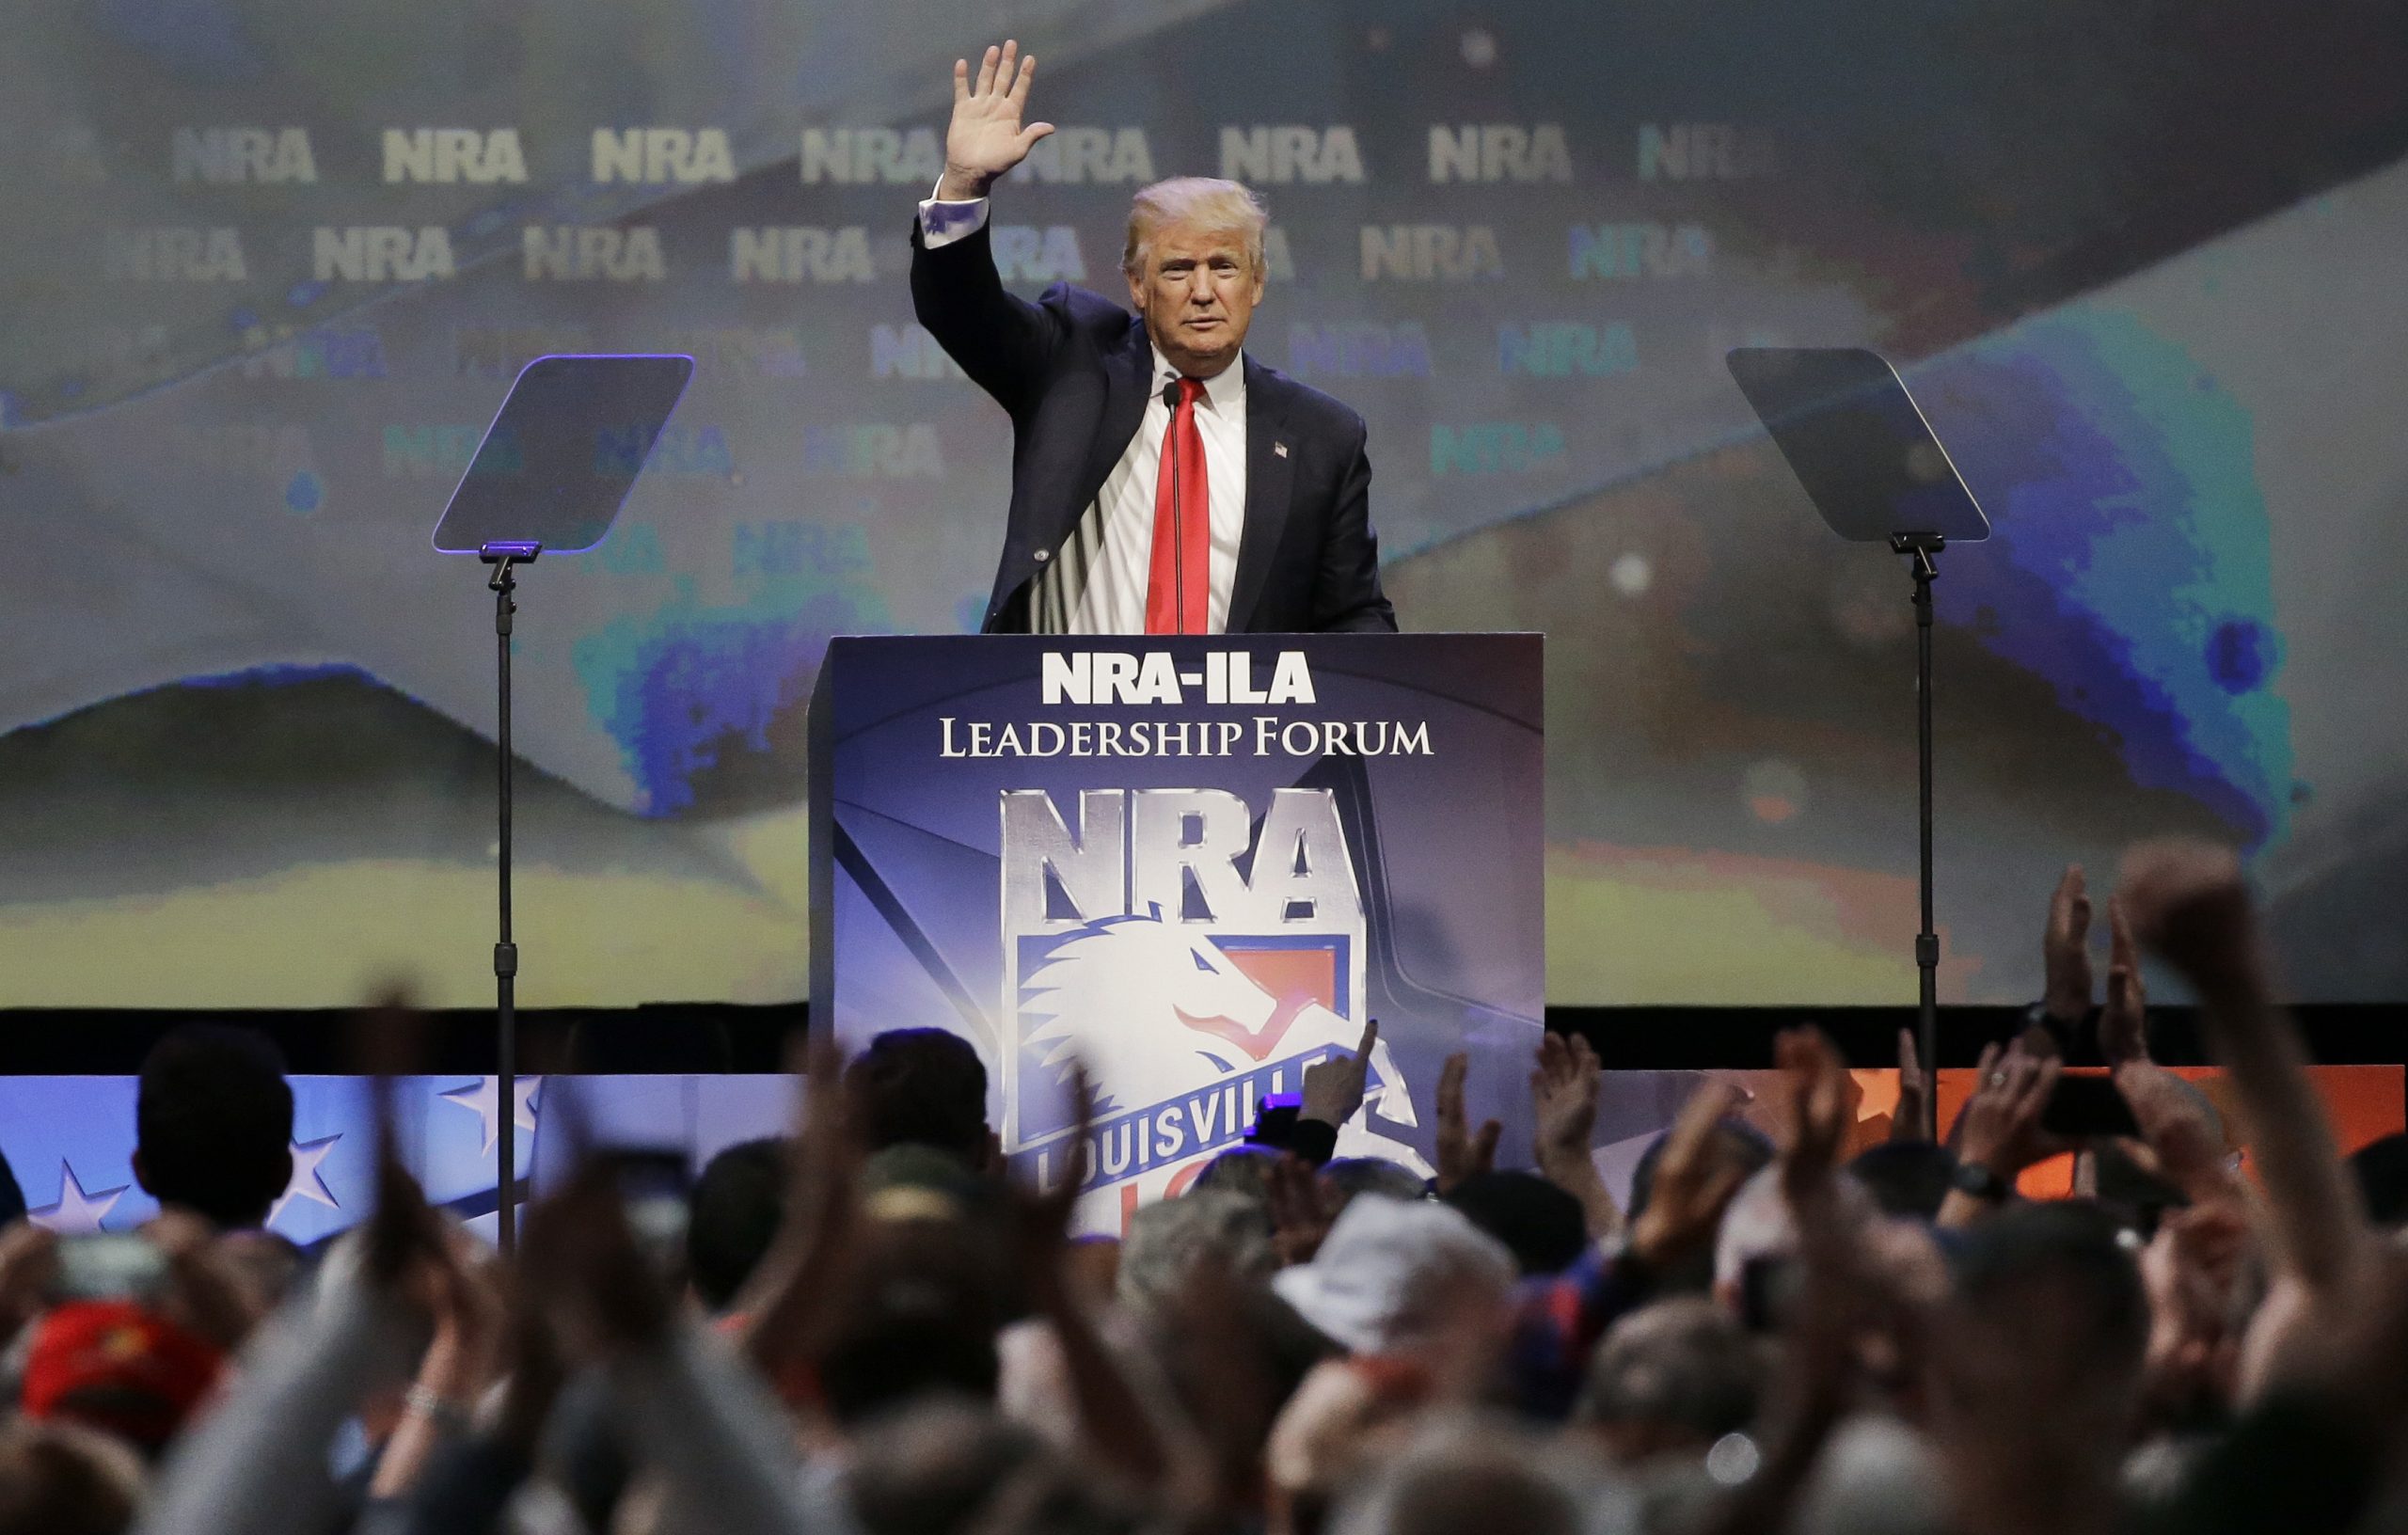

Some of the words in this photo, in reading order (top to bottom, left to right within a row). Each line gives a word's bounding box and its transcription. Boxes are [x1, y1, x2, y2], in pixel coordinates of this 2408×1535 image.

[173, 127, 318, 183] NRA
[381, 127, 529, 183] NRA
[591, 126, 737, 183] NRA
[800, 126, 944, 183] NRA
[1217, 124, 1366, 183] NRA
[1427, 123, 1574, 182] NRA
[311, 226, 458, 281] NRA
[522, 225, 666, 280] NRA
[730, 226, 876, 281] NRA
[988, 225, 1086, 280] RA
[1358, 224, 1506, 279] NRA
[1566, 223, 1714, 279] NRA
[1496, 321, 1640, 376] NRA
[1042, 651, 1317, 705] NRA-ILA
[940, 718, 1243, 758] LEADERSHIP
[1252, 717, 1435, 757] FORUM
[999, 787, 1367, 926] NRA
